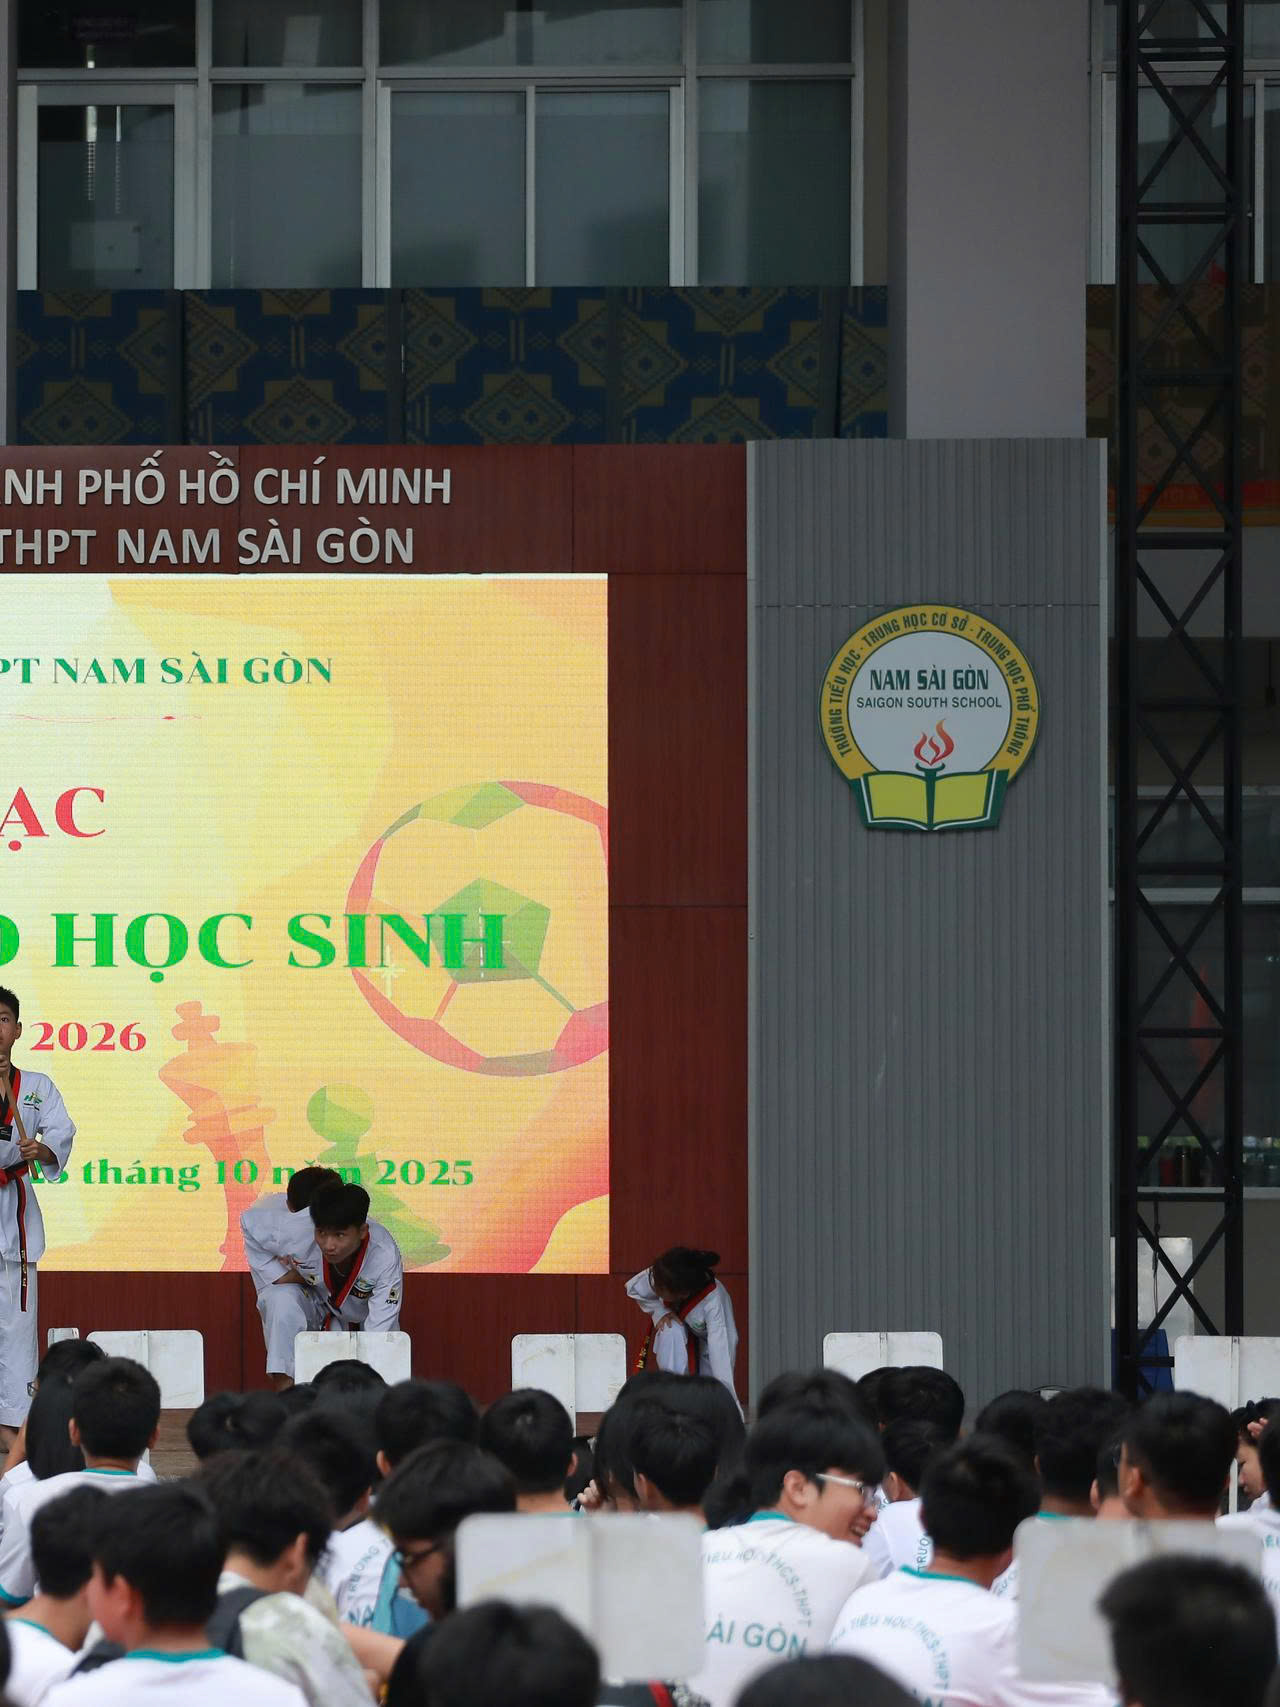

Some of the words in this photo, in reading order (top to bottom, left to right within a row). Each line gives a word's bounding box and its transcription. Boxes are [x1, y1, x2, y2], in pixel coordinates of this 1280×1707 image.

[78, 450, 166, 506] PHỐ
[179, 451, 240, 505] HỒ
[253, 456, 327, 505] CHÍ
[336, 468, 451, 505] MINH
[118, 528, 221, 565] NAM
[238, 518, 302, 565] SÀI
[316, 516, 415, 565] GÒN
[861, 618, 901, 648] TRUNG
[902, 613, 927, 630] HỌC
[931, 612, 948, 627] CƠ
[951, 614, 969, 632] SỞ
[975, 626, 1011, 661] TRUNG
[52, 657, 147, 685] NAM
[160, 652, 229, 685] SÀI
[243, 651, 333, 685] GÒN
[839, 649, 861, 675] HỌC
[1004, 658, 1025, 685] HỌC
[870, 669, 910, 691] NAM
[917, 664, 946, 691] SÀI
[952, 664, 989, 691] GÒN
[856, 697, 903, 709] SAIGON
[907, 697, 948, 709] SOUTH
[951, 697, 1002, 709] SCHOOL
[828, 708, 852, 757] TRƯỜNG
[1007, 717, 1030, 757] THÔNG
[51, 912, 254, 983] HỌC
[287, 912, 508, 969] SINH
[30, 1022, 147, 1052] 2026
[82, 1159, 201, 1193] tháng
[214, 1159, 258, 1185] 10
[375, 1159, 474, 1185] 2025
